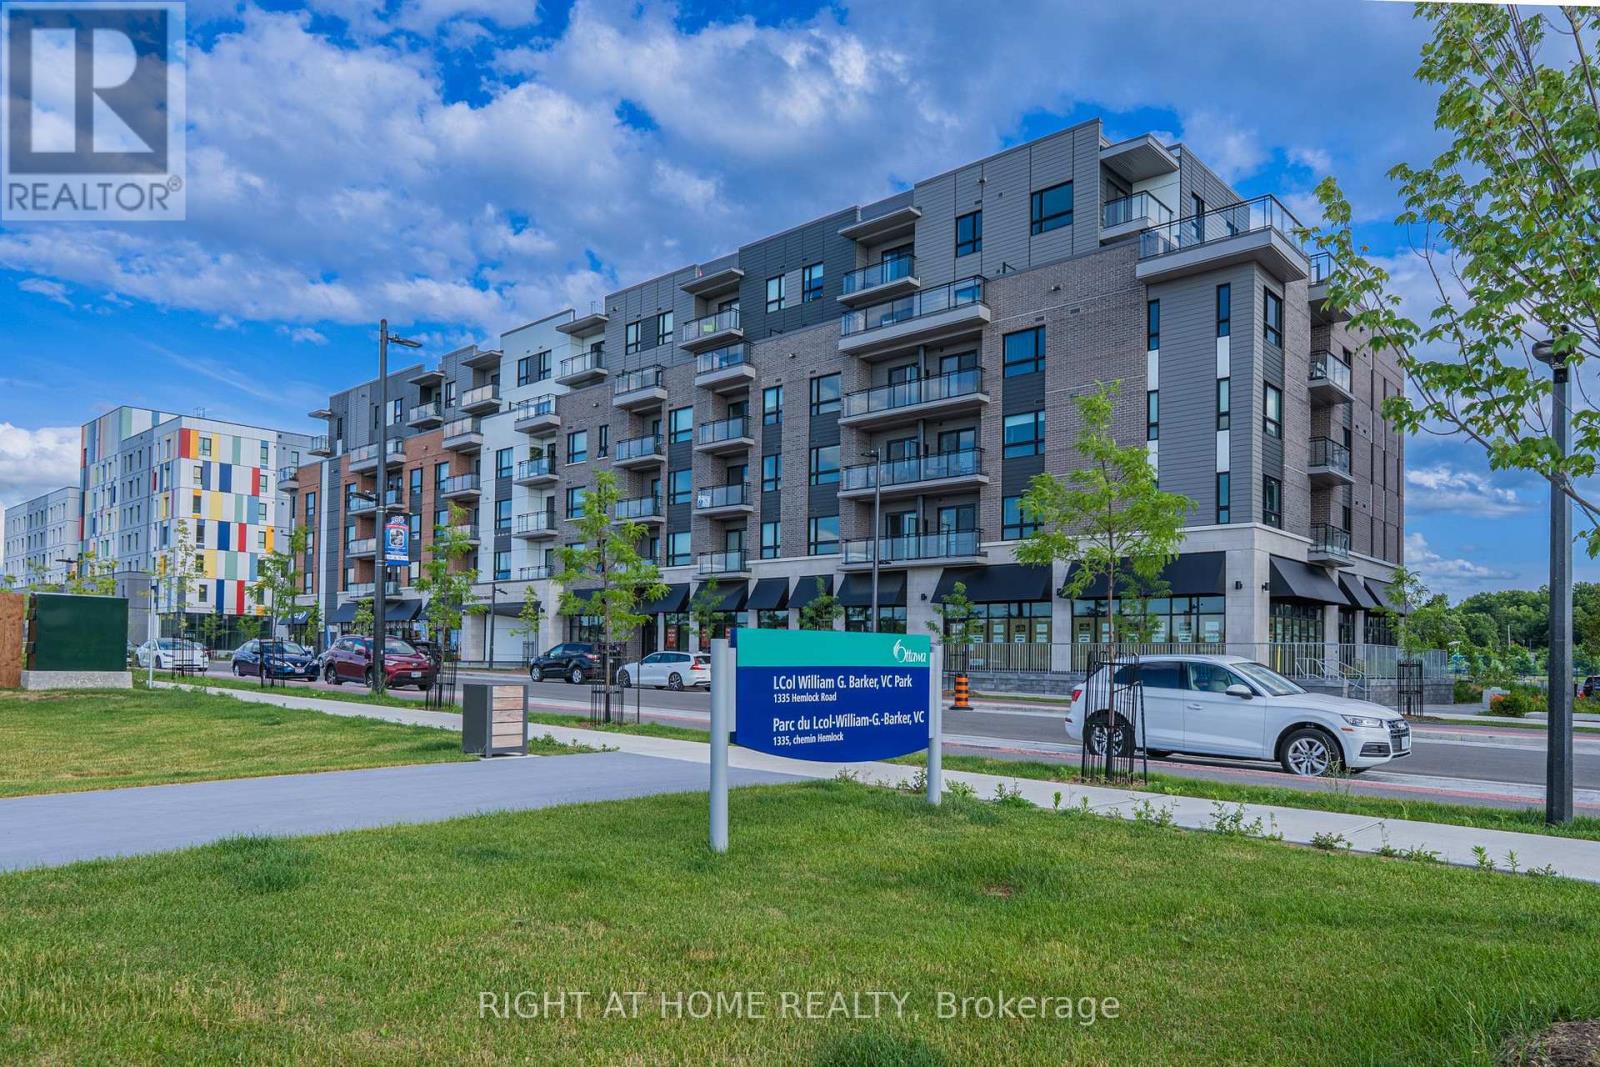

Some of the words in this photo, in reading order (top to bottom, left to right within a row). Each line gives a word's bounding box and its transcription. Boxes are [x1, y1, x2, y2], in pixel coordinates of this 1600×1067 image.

[893, 639, 926, 663] Ottawa
[773, 675, 796, 690] LCol
[798, 674, 835, 689] William
[837, 675, 847, 689] G.
[849, 674, 879, 690] Barker,
[880, 675, 893, 688] VC
[894, 674, 913, 688] Park
[773, 693, 790, 703] 1335
[791, 692, 820, 702] Hemlock
[820, 691, 837, 702] Road
[773, 718, 795, 732] Parc
[797, 715, 810, 730] du
[913, 710, 925, 724] VC
[773, 735, 792, 747] 1335,
[792, 733, 816, 745] chemin
[817, 731, 844, 743] Hemlock
